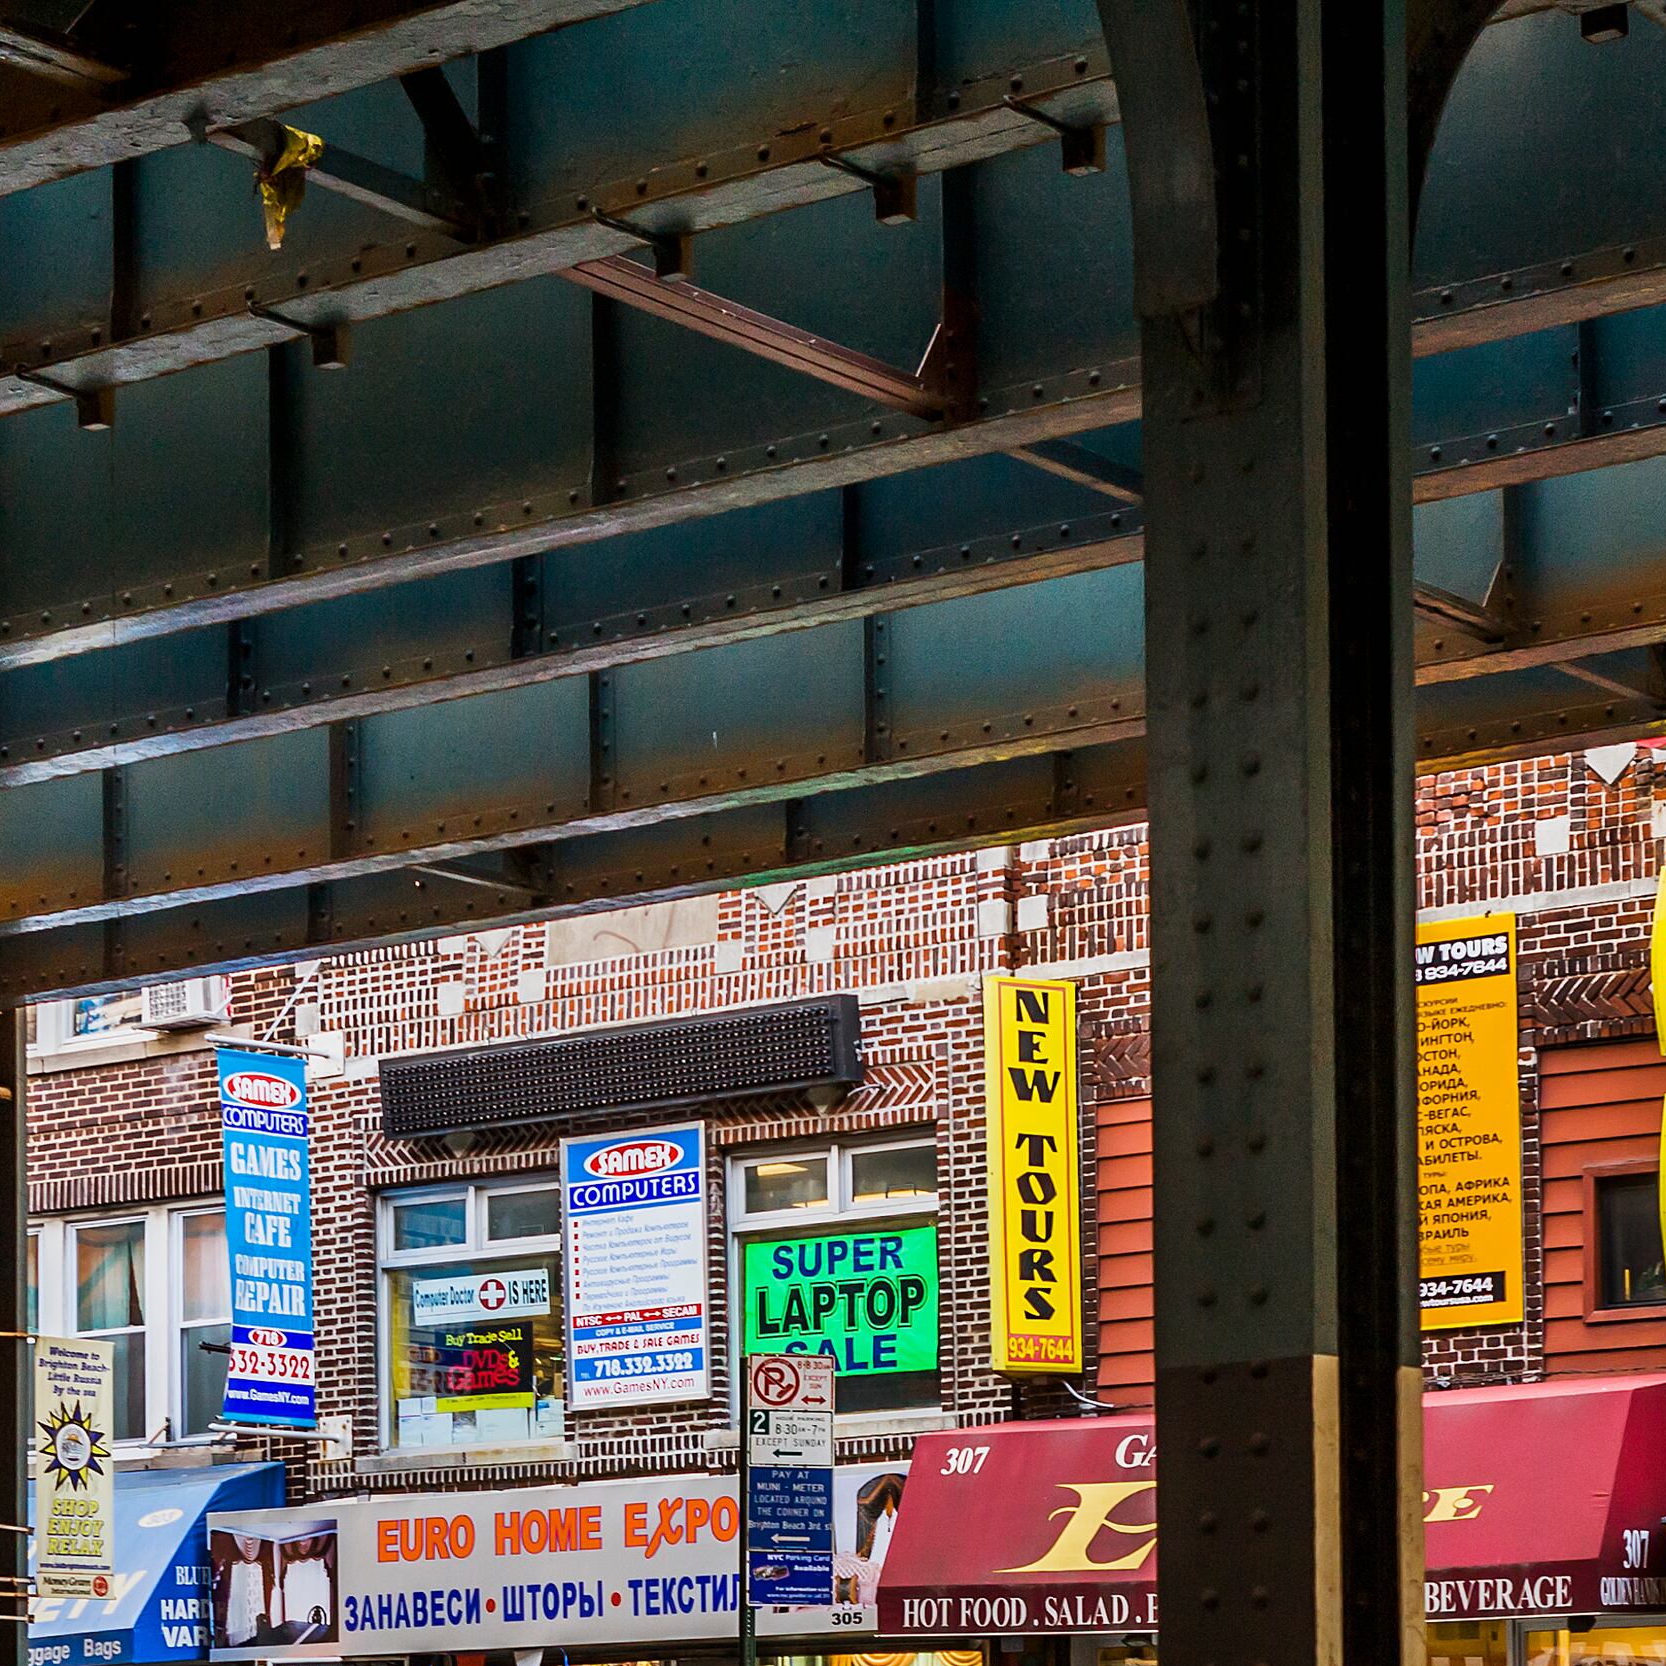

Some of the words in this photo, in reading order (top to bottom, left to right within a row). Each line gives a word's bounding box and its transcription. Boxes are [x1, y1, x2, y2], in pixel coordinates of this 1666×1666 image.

[1440, 935, 1507, 962] TOURS
[1007, 989, 1061, 1104] NEW
[232, 1076, 291, 1108] SAMEX
[223, 1105, 304, 1135] COMPUTERS
[230, 1141, 302, 1181] GAMES
[597, 1144, 671, 1175] SAMEX
[573, 1174, 695, 1206] COMPUTERS
[1456, 1177, 1510, 1192] АФРИКА
[233, 1186, 301, 1214] INTERNET
[244, 1212, 292, 1248] CAFE
[1015, 1133, 1058, 1321] TOURS
[235, 1253, 305, 1282] COMPUTER
[772, 1236, 903, 1280] SUPER
[235, 1279, 306, 1317] REPAIR
[508, 1280, 519, 1305] IS
[522, 1278, 547, 1304] HERE
[576, 1316, 602, 1327] NTSC
[624, 1312, 643, 1322] PAL
[662, 1306, 697, 1318] SECAM
[756, 1274, 928, 1339] LAPTOP
[498, 1328, 523, 1343] Sell
[643, 1337, 662, 1348] SALE
[667, 1334, 700, 1345] GAMES
[1008, 1336, 1074, 1362] 934-7644
[594, 1352, 693, 1377] 718.332.3322
[447, 1366, 521, 1391] Games
[584, 1377, 694, 1397] www.GamesNY.com
[753, 1411, 766, 1434] 2
[793, 1439, 826, 1448] SUNDAY
[940, 1446, 990, 1476] 307
[756, 1482, 781, 1492] MUNI
[792, 1483, 825, 1493] METER
[771, 1470, 792, 1479] PAY
[797, 1471, 810, 1480] AT
[52, 1498, 100, 1518] SHOP
[754, 1494, 790, 1504] LOCATED
[795, 1496, 828, 1506] AROUND
[757, 1506, 773, 1516] THE
[776, 1507, 809, 1517] CORNER
[813, 1508, 825, 1518] ON
[47, 1518, 104, 1538] ENJOY
[377, 1514, 475, 1563] EURO
[495, 1505, 604, 1556] HOME
[624, 1495, 739, 1558] EXPO
[782, 1521, 806, 1530] Beach
[47, 1538, 104, 1558] RELAX
[766, 1553, 784, 1561] NYC
[1622, 1530, 1650, 1569] 307
[793, 1564, 830, 1572] Available
[43, 1576, 91, 1587] MoneyGram
[51, 1587, 91, 1596] International
[344, 1588, 481, 1632] ЗАНАВЕСИ
[503, 1580, 604, 1623] ШТОРЫ
[902, 1598, 953, 1628] HOT
[959, 1597, 1027, 1627] FOOD
[1044, 1593, 1130, 1627] SALAD
[1424, 1575, 1573, 1613] BEVERAGE
[831, 1611, 863, 1627] 305
[83, 1638, 122, 1661] Bags
